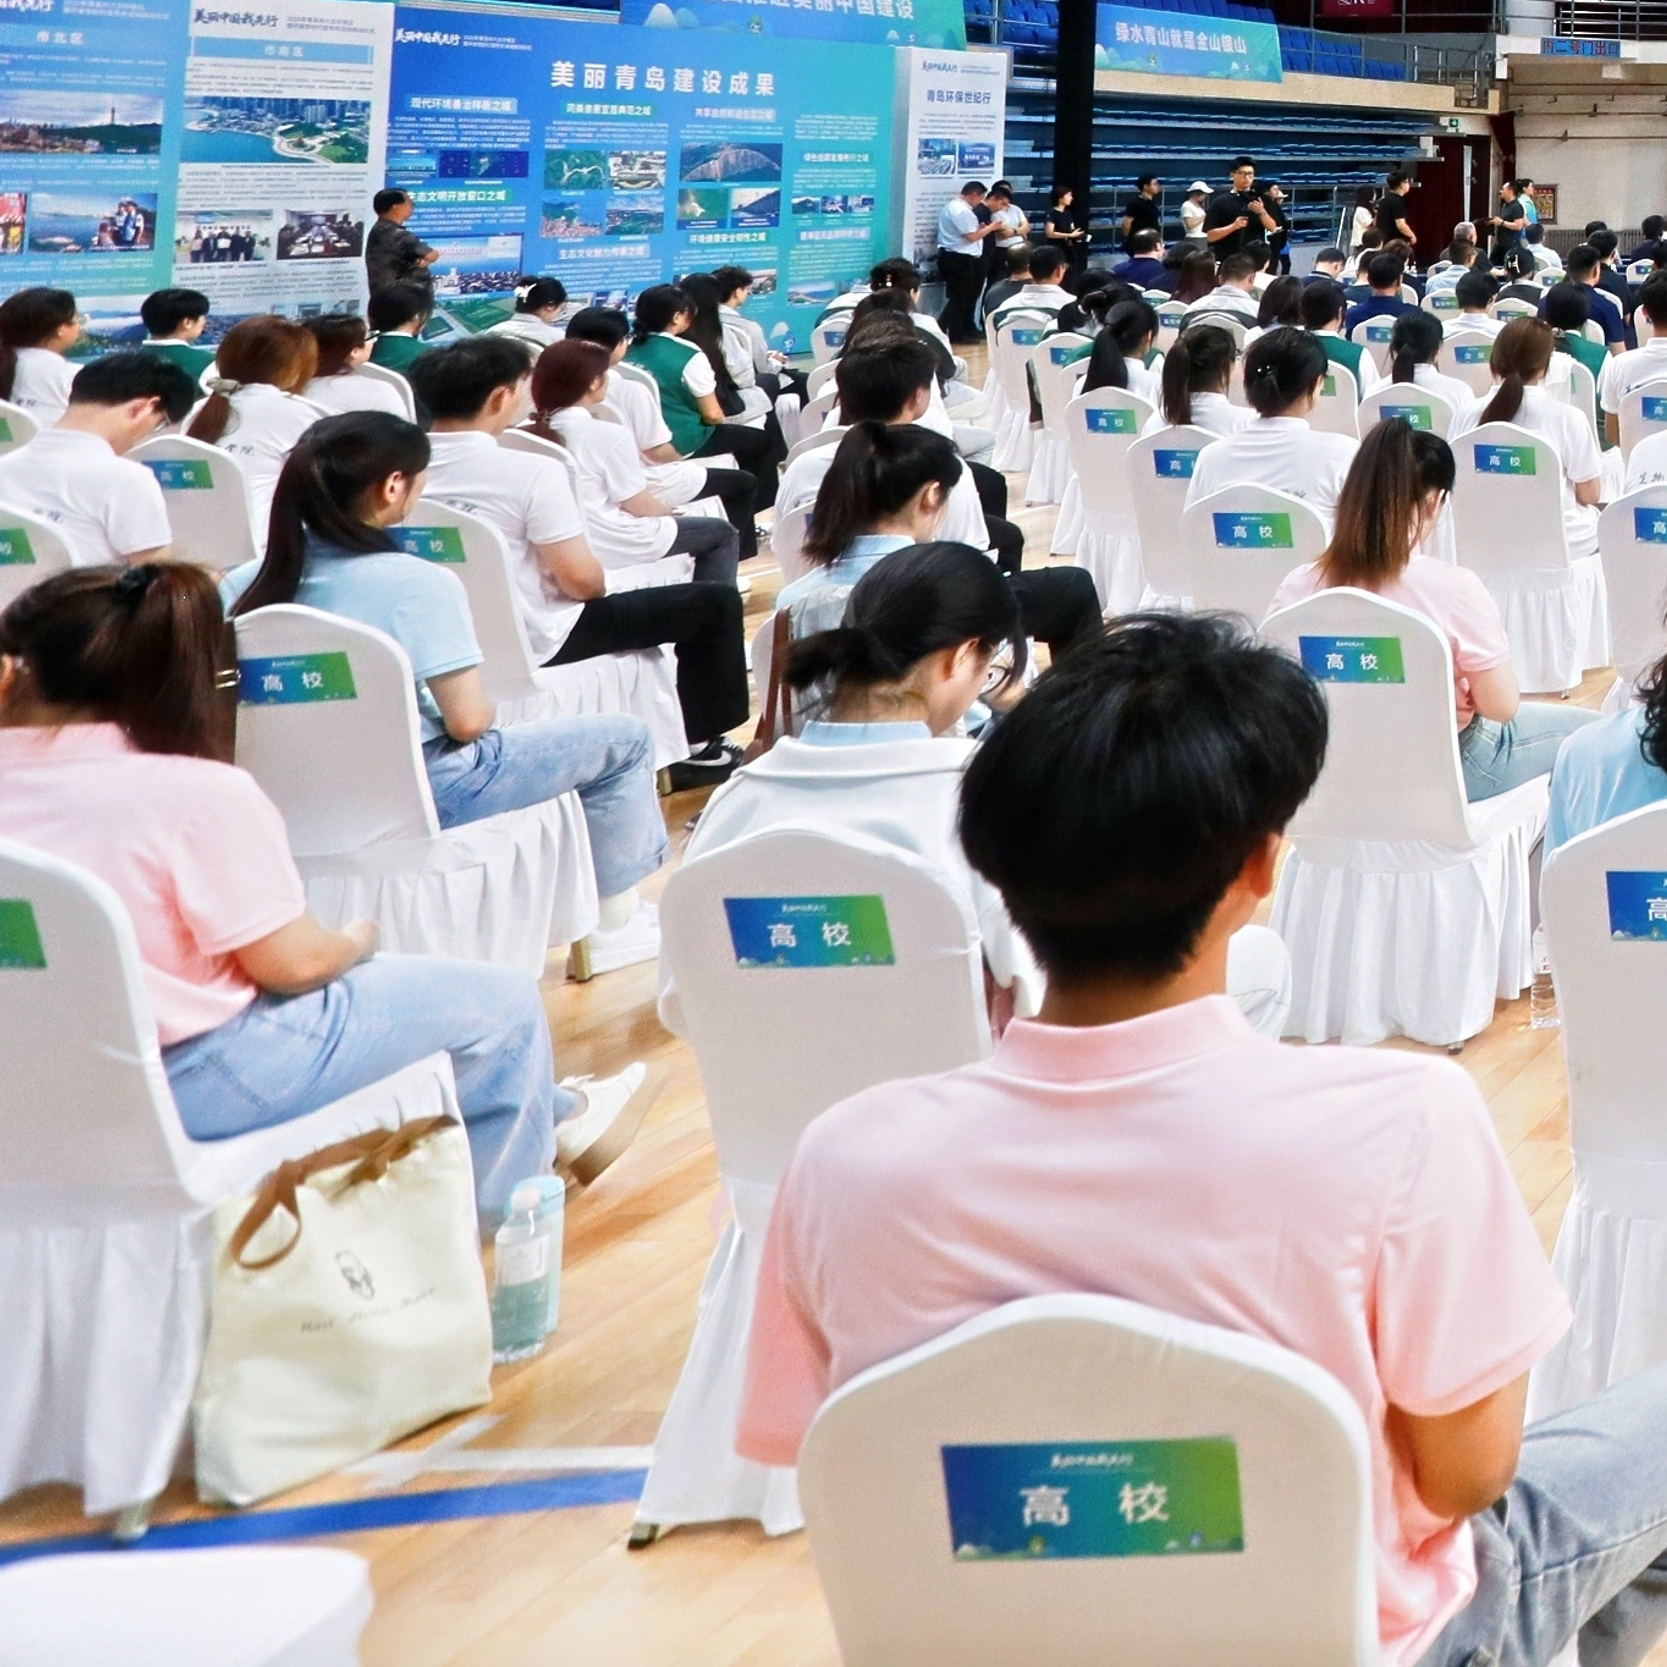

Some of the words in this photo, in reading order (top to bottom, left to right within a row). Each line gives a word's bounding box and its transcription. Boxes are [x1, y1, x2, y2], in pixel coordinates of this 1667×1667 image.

[1115, 21, 1247, 54] 绿水青山就是金山银山
[1541, 39, 1620, 57] 内二号门出口
[551, 61, 776, 96] 美丽青岛建设成果
[927, 89, 991, 104] 青岛环保世纪行
[1489, 455, 1520, 468] 高校
[160, 470, 195, 482] 高校
[1234, 524, 1273, 539] 高校
[404, 538, 444, 553] 高校
[1326, 653, 1378, 671] 高校
[262, 672, 325, 692] 高校
[768, 922, 853, 948] 高校
[1020, 1481, 1171, 1528] 高校
